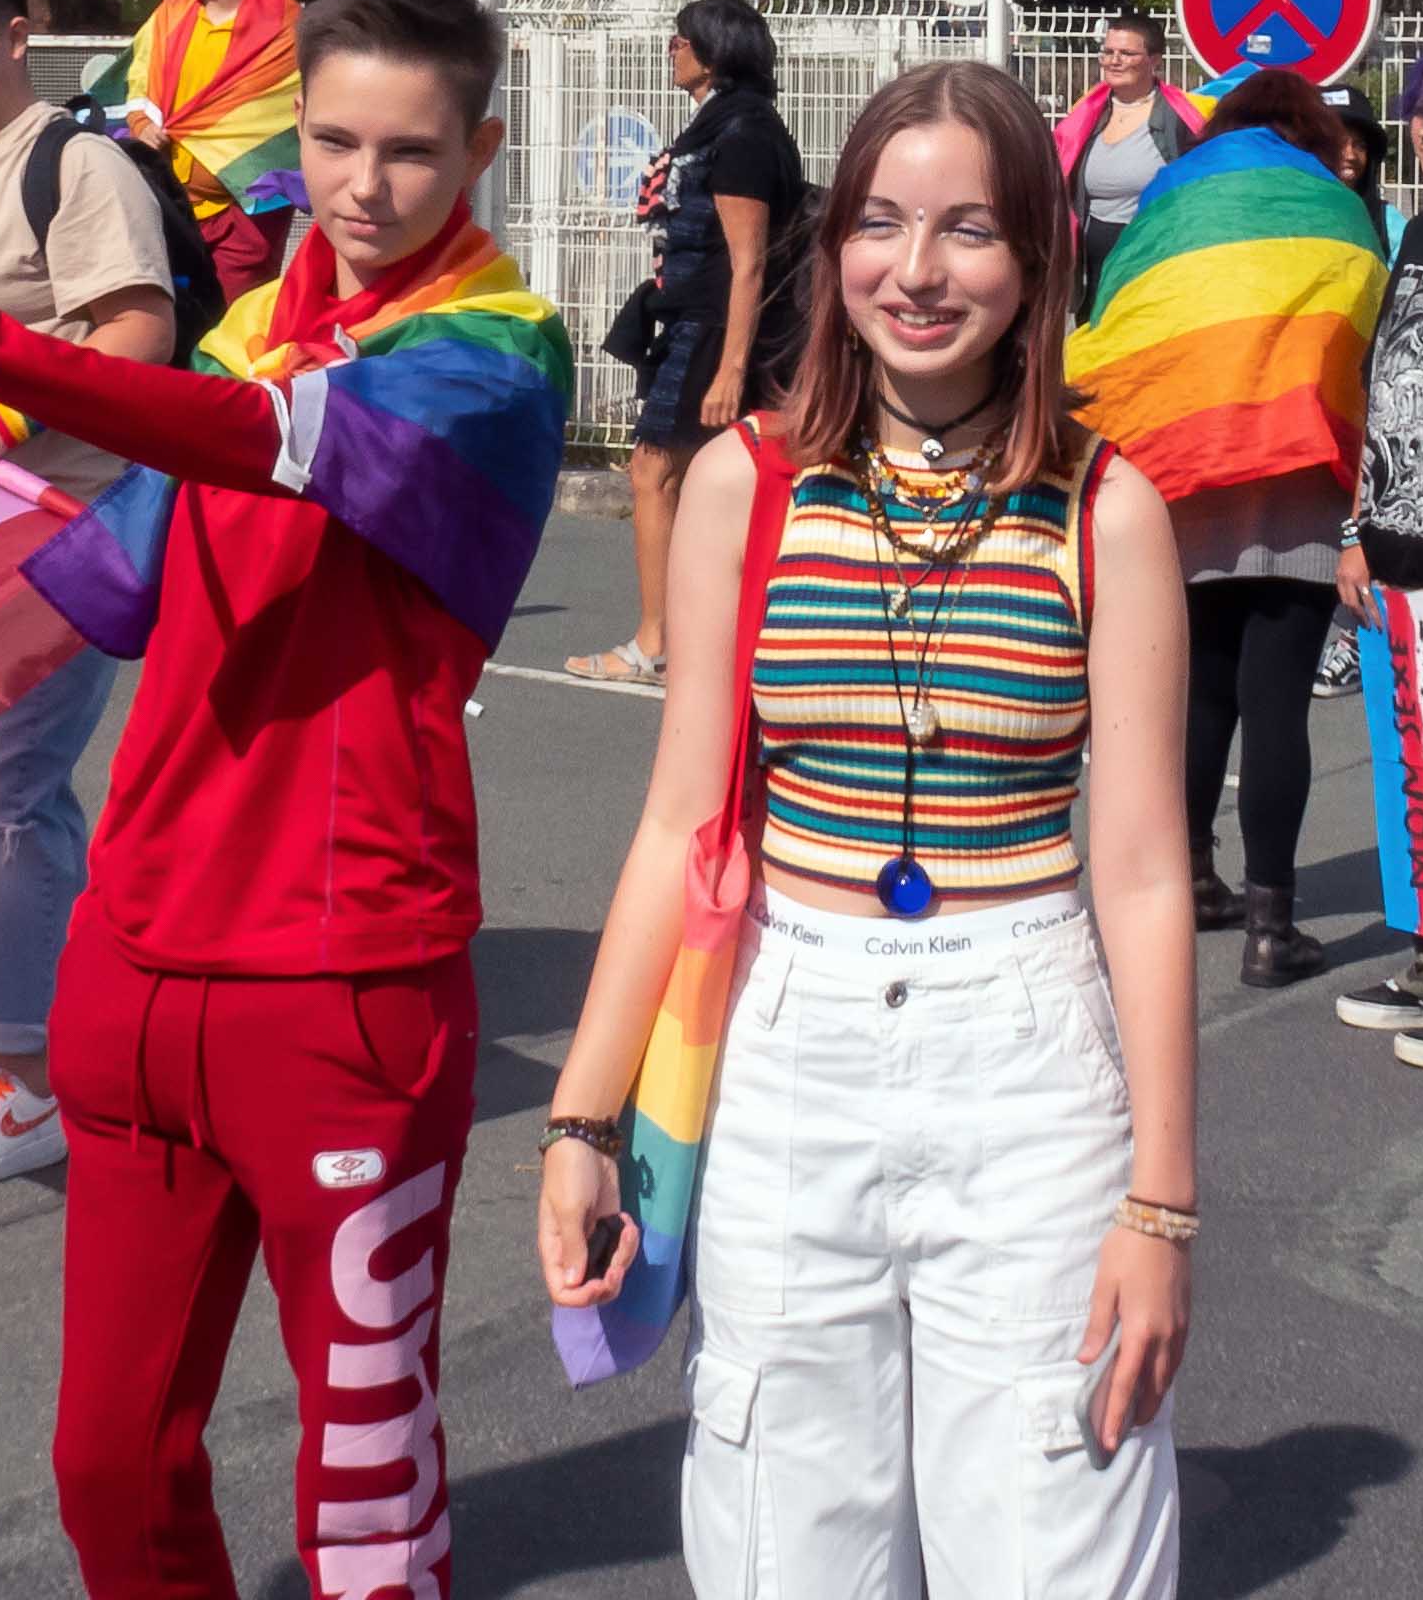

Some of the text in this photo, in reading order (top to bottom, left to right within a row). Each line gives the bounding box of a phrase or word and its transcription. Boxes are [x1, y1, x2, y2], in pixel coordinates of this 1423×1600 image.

[1389, 635, 1422, 743] SEXE
[790, 922, 825, 949] Klein
[864, 934, 973, 957] Calvin Klein
